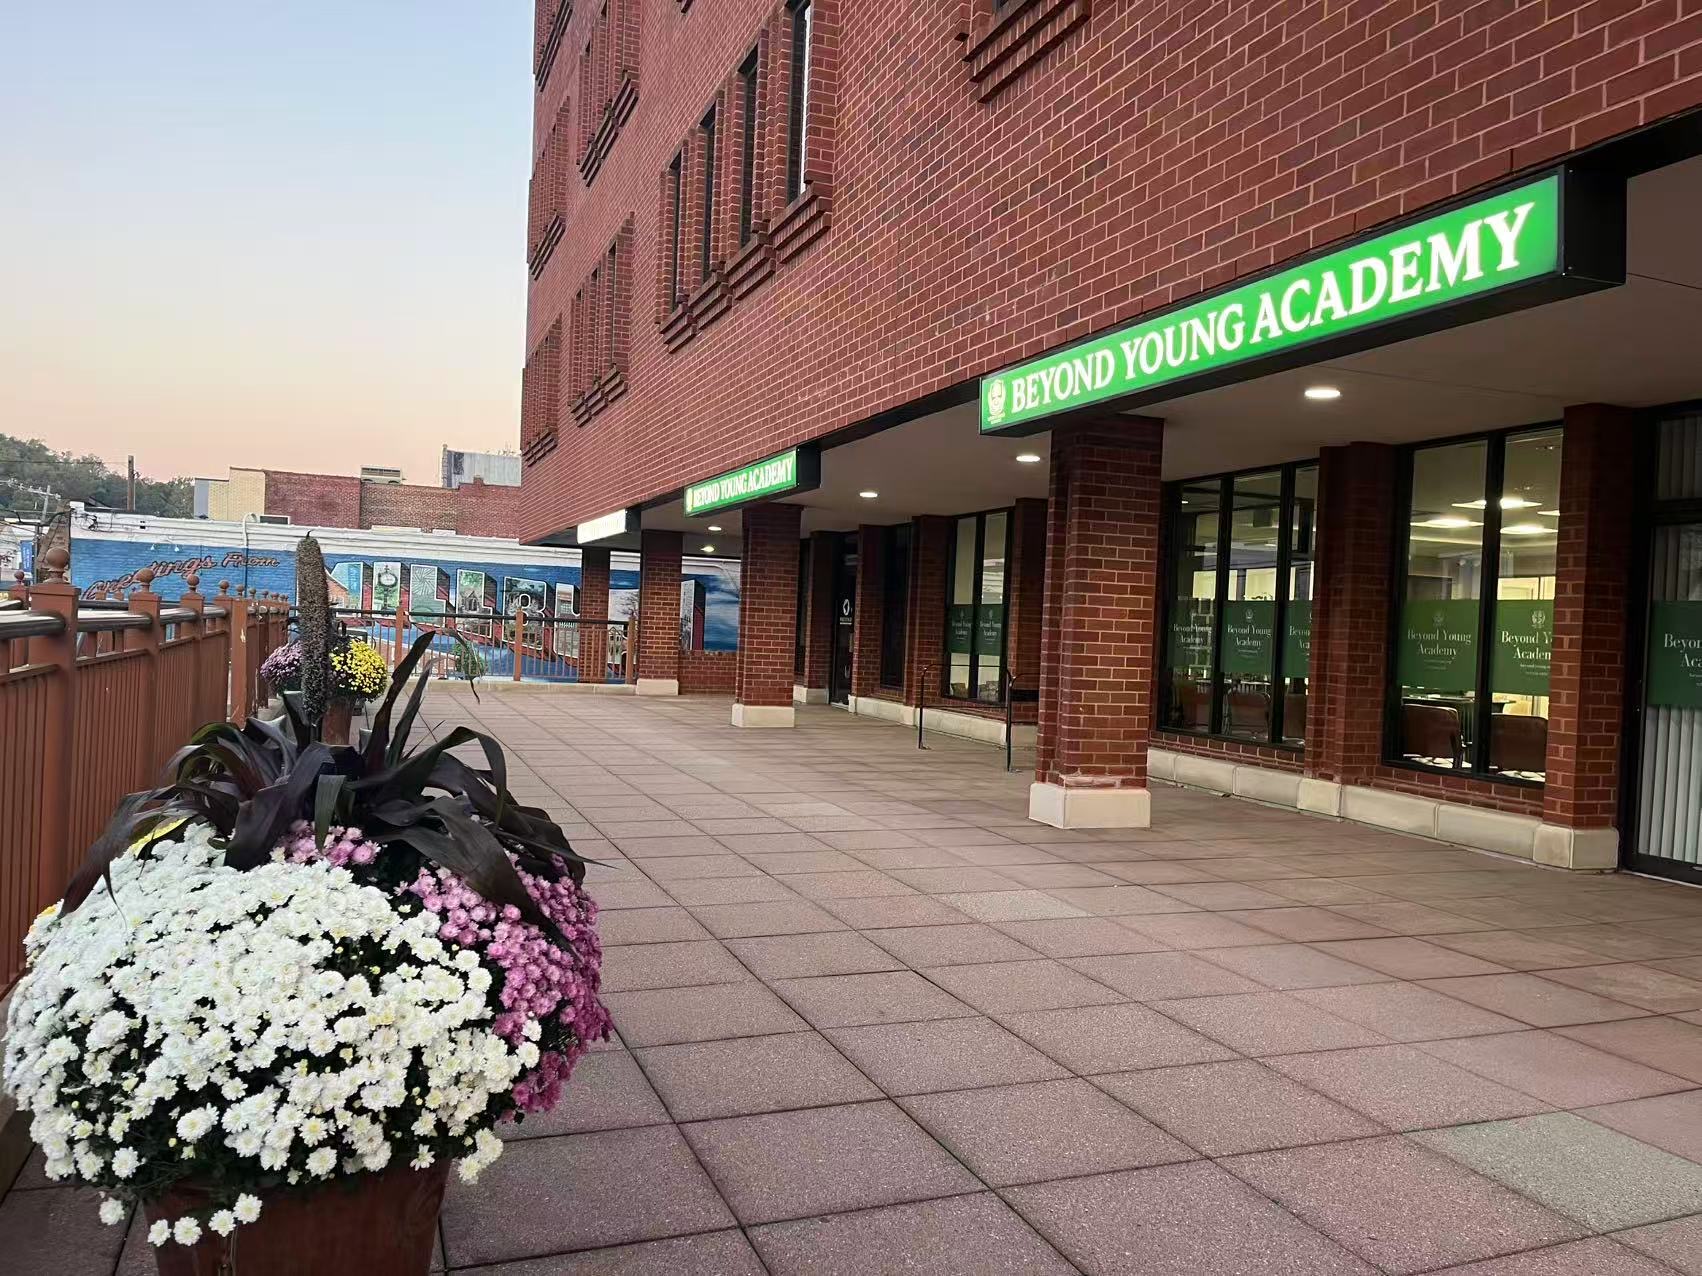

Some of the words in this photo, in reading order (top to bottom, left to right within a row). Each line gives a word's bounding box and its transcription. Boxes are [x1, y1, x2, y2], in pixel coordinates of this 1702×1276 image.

[1011, 350, 1115, 413] BEYOND
[1119, 304, 1246, 380] YOUNG
[1250, 201, 1537, 342] ACADEMY
[693, 481, 720, 507] BEYOND
[720, 473, 747, 499] YOUNG
[748, 458, 793, 491] ACADEMY
[1227, 624, 1250, 637] Beyond
[1251, 624, 1272, 638] Young
[1289, 625, 1311, 638] Beyon
[1407, 629, 1439, 644] Beyond
[1442, 630, 1471, 645] Young
[1501, 630, 1538, 647] Beyond
[1236, 637, 1261, 649] Academy
[1664, 633, 1702, 653] Beyon
[1418, 644, 1457, 659] Academy
[1513, 647, 1551, 660] Academ
